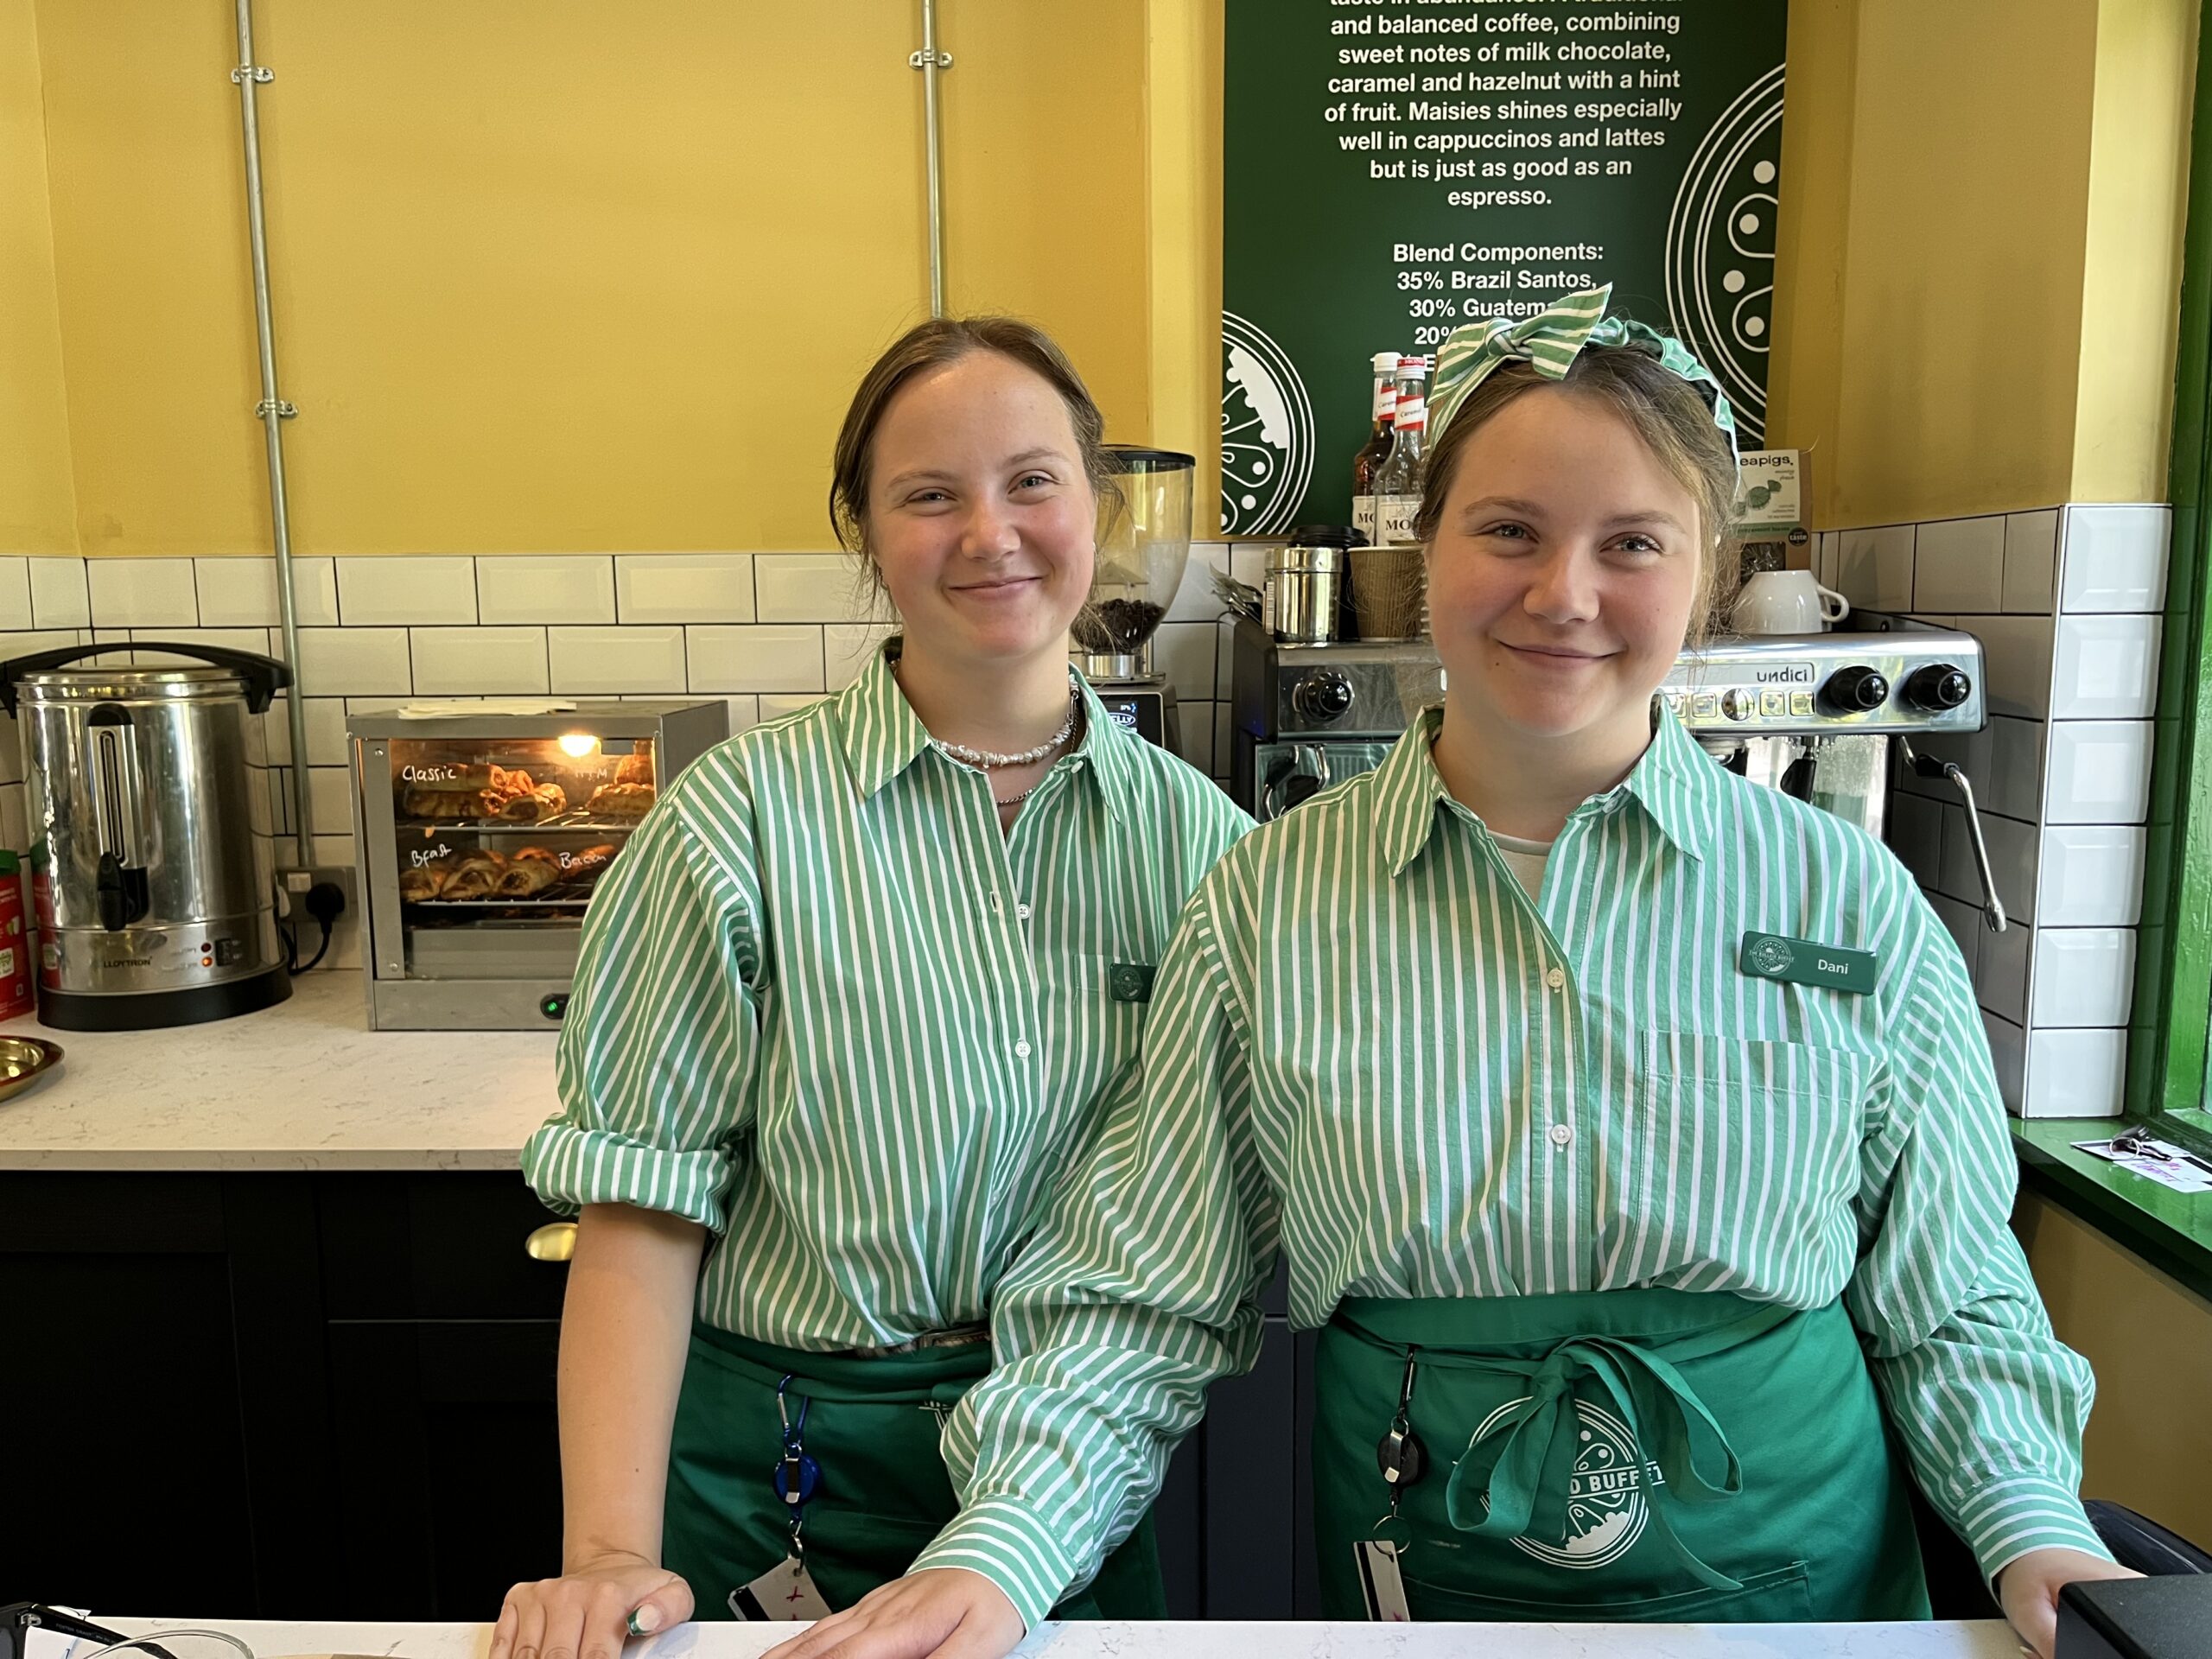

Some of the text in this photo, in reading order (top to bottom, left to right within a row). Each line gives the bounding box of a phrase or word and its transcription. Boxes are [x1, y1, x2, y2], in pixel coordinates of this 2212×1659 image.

[1332, 12, 1679, 35] and balanced coffee, combining
[1339, 41, 1670, 63] sweet notes of milk chocolate,
[1328, 70, 1680, 92] caramel and hazelnut with a hint
[1325, 99, 1681, 122] of fruit. Maisies shines especially
[1339, 128, 1664, 153] well in cappuccinos and lattes
[1370, 157, 1631, 181] but is just as good as an
[1448, 191, 1551, 209] espresso.
[1394, 243, 1603, 264] Blend Components:
[1397, 270, 1597, 289] 35% Brazil Santos,
[1409, 299, 1456, 317] 30%
[1757, 665, 1808, 683] undici
[402, 765, 457, 781] Classic
[1817, 958, 1849, 975] Dani
